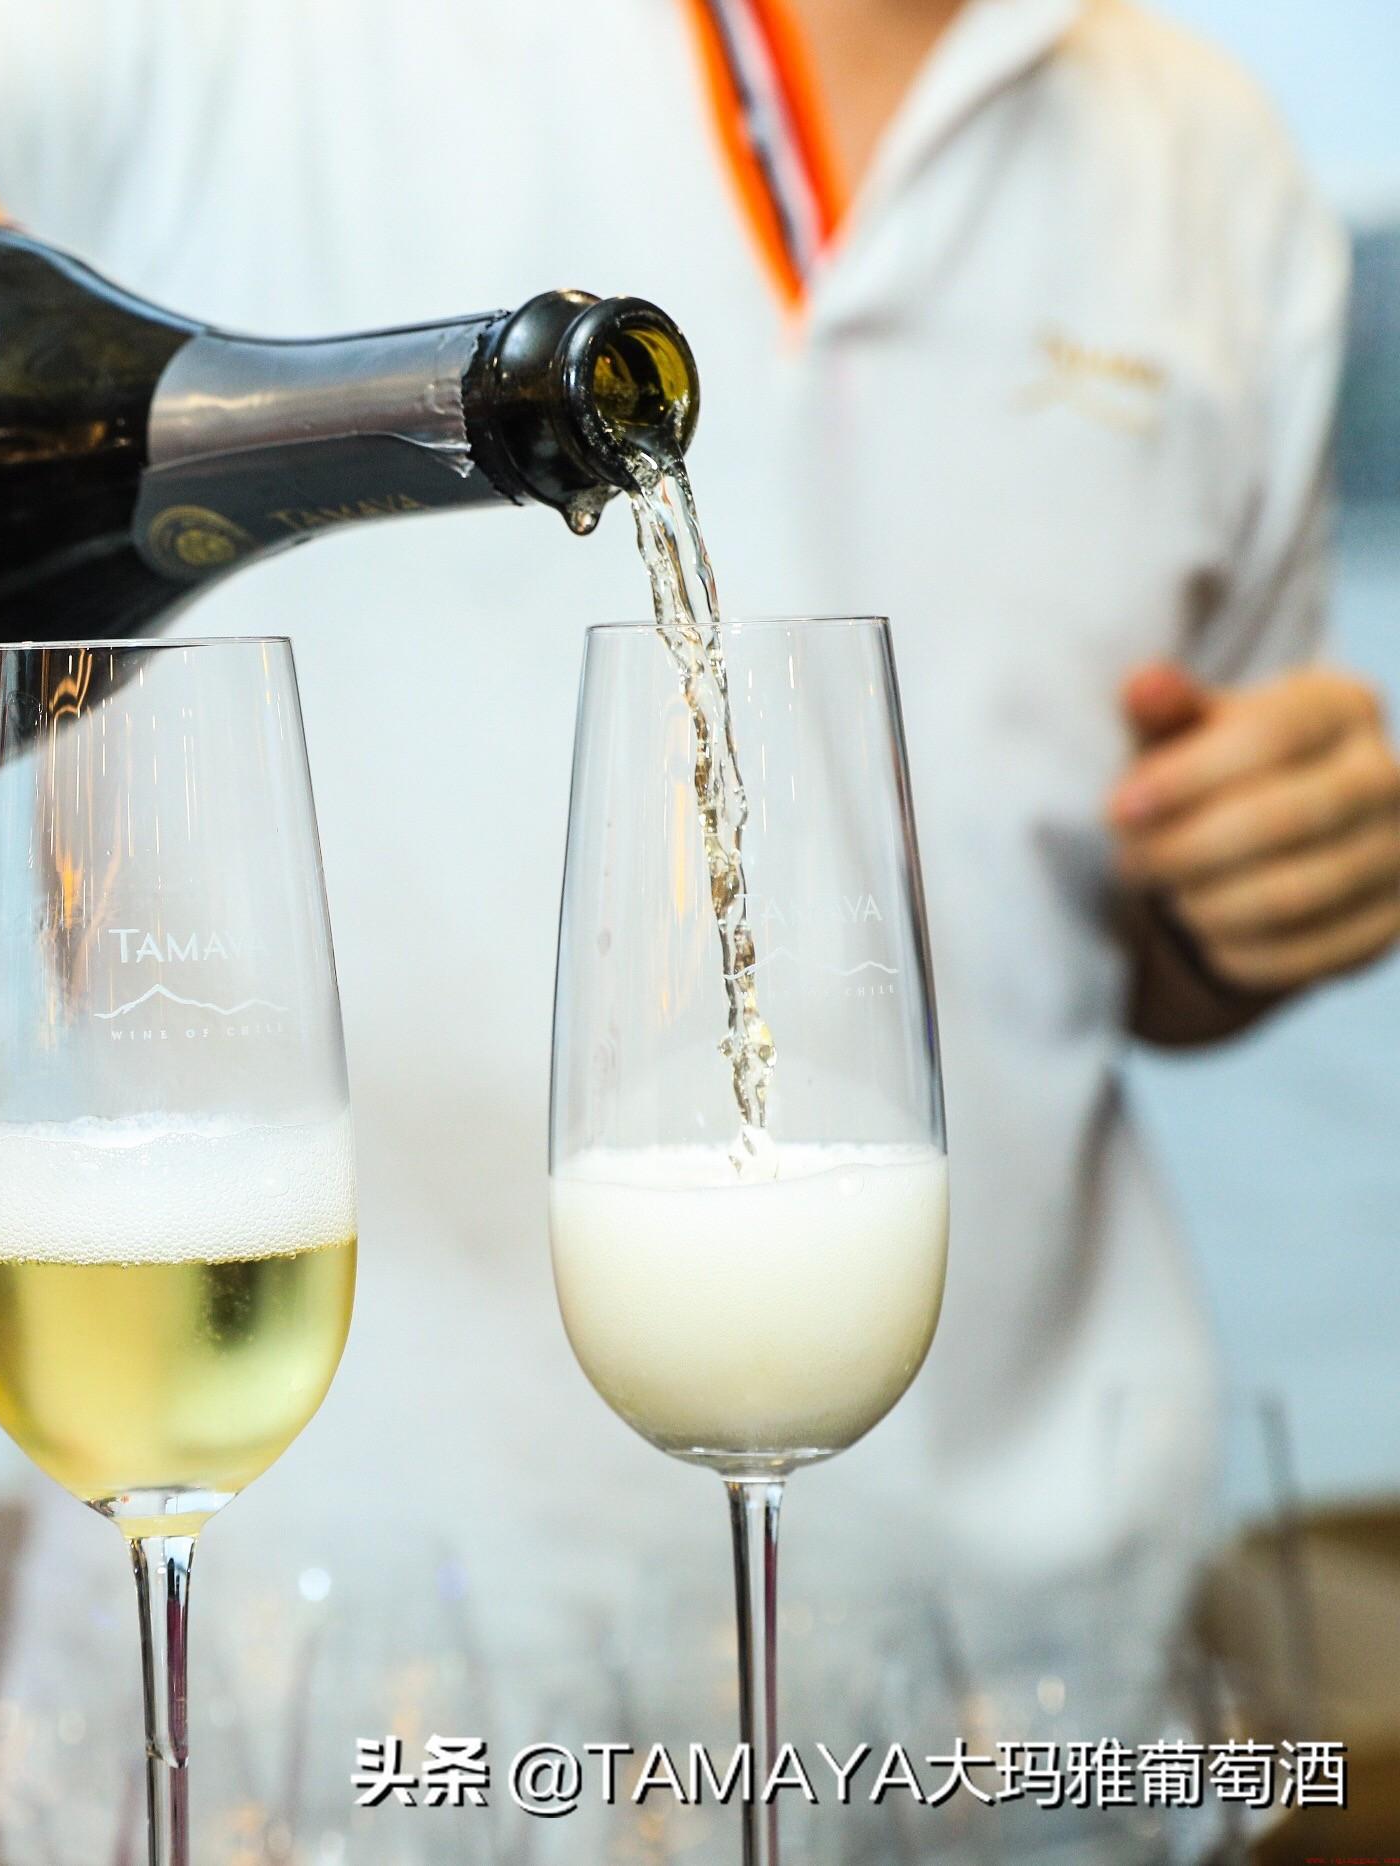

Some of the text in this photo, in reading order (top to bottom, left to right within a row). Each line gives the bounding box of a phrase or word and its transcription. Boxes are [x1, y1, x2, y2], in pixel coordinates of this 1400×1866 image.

[734, 892, 883, 925] TAYA
[108, 928, 264, 964] TAMAY
[111, 1029, 169, 1041] WINE
